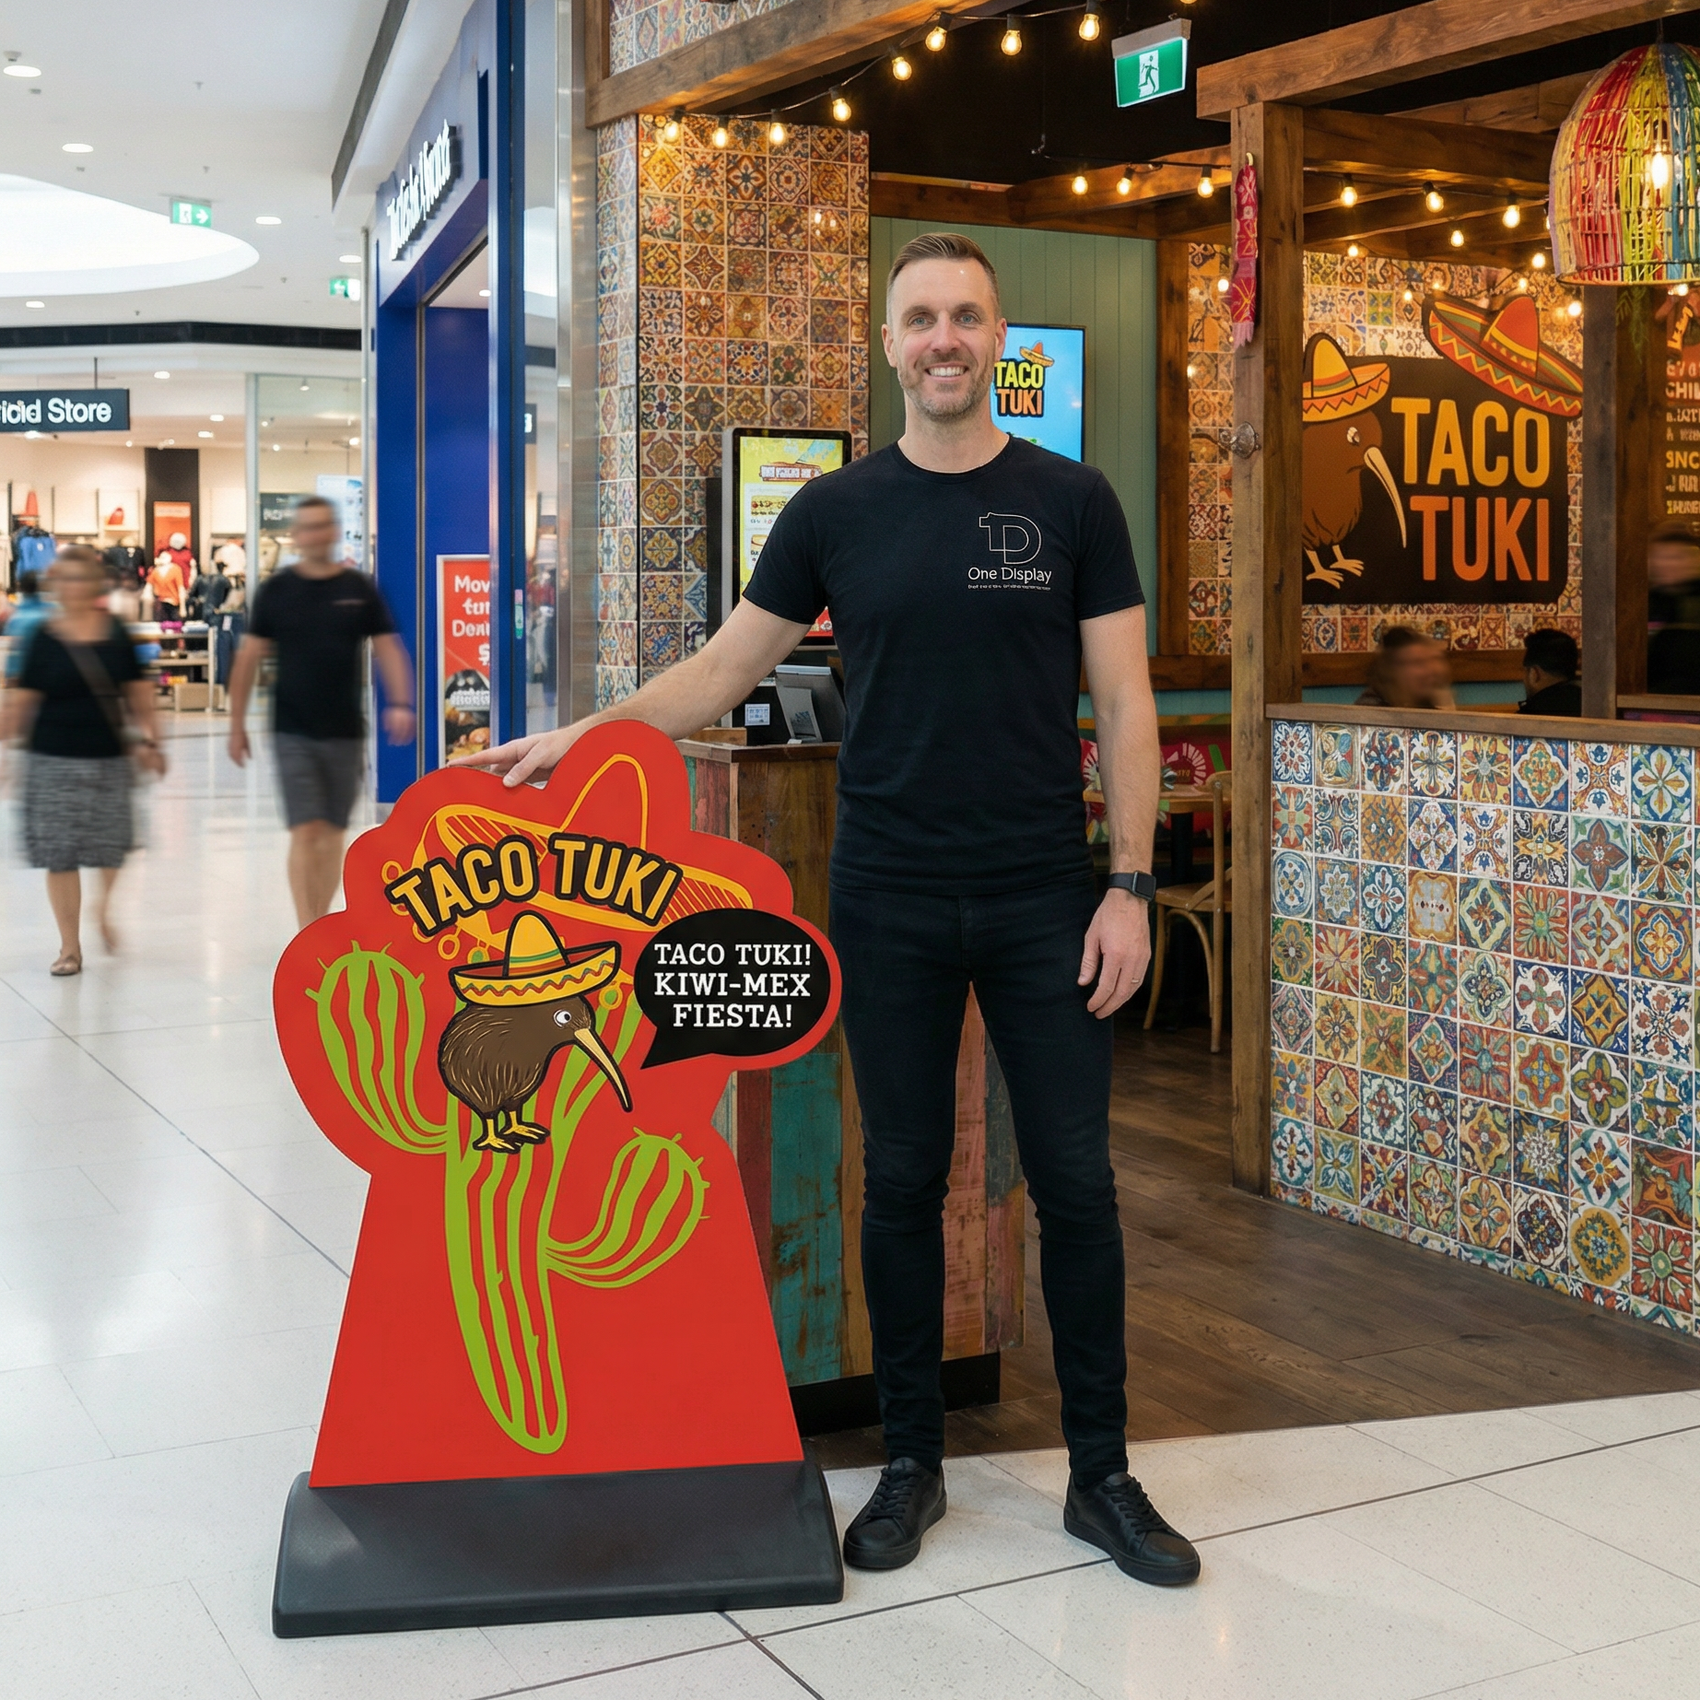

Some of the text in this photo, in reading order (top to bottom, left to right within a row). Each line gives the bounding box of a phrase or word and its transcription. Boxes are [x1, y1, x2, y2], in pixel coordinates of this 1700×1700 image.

[994, 361, 1044, 388] TACO
[48, 397, 112, 424] Store
[997, 388, 1043, 415] TUKI
[1391, 397, 1549, 488] TACO
[1410, 495, 1549, 581] TUKI
[968, 567, 998, 580] One
[389, 837, 679, 933] TACO TUKI
[654, 943, 811, 966] TACO TUKI!
[654, 972, 811, 997] KIWI-MEX
[673, 1003, 792, 1028] FIESTA!
